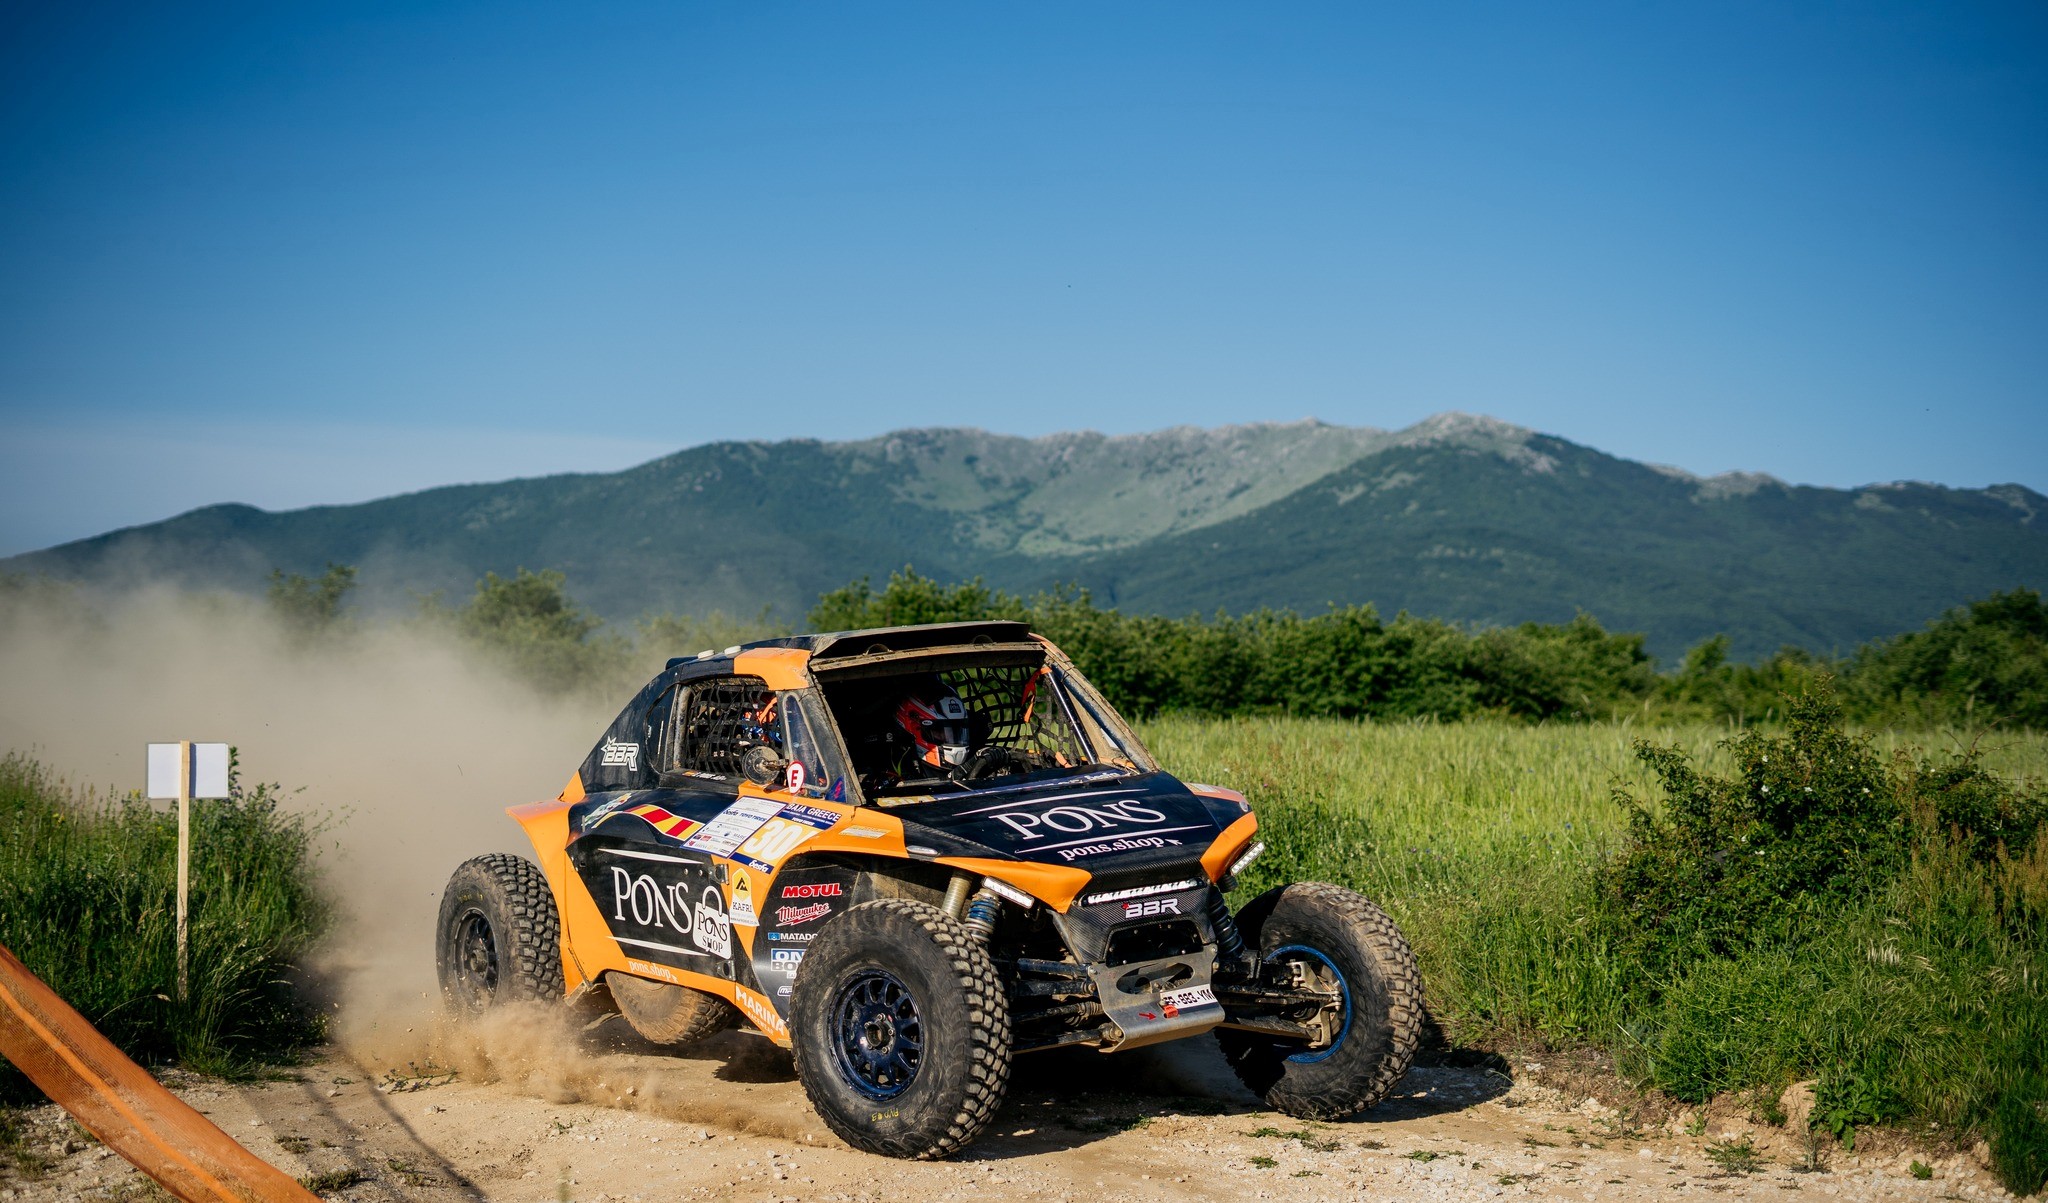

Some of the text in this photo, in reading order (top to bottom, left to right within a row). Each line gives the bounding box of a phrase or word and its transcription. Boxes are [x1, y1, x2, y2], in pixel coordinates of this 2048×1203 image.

[602, 743, 639, 771] BBR
[791, 770, 798, 787] E
[807, 808, 842, 822] GREECE
[988, 800, 1166, 840] PONS
[1057, 837, 1165, 861] pons.shop
[611, 866, 692, 934] PONS
[782, 883, 842, 898] MOTUL
[775, 902, 829, 922] Milwaukee
[1125, 898, 1182, 918] BBR
[697, 910, 728, 941] PONS
[702, 935, 723, 953] SHOP
[628, 960, 671, 982] pons.shop
[736, 985, 784, 1036] MARINA
